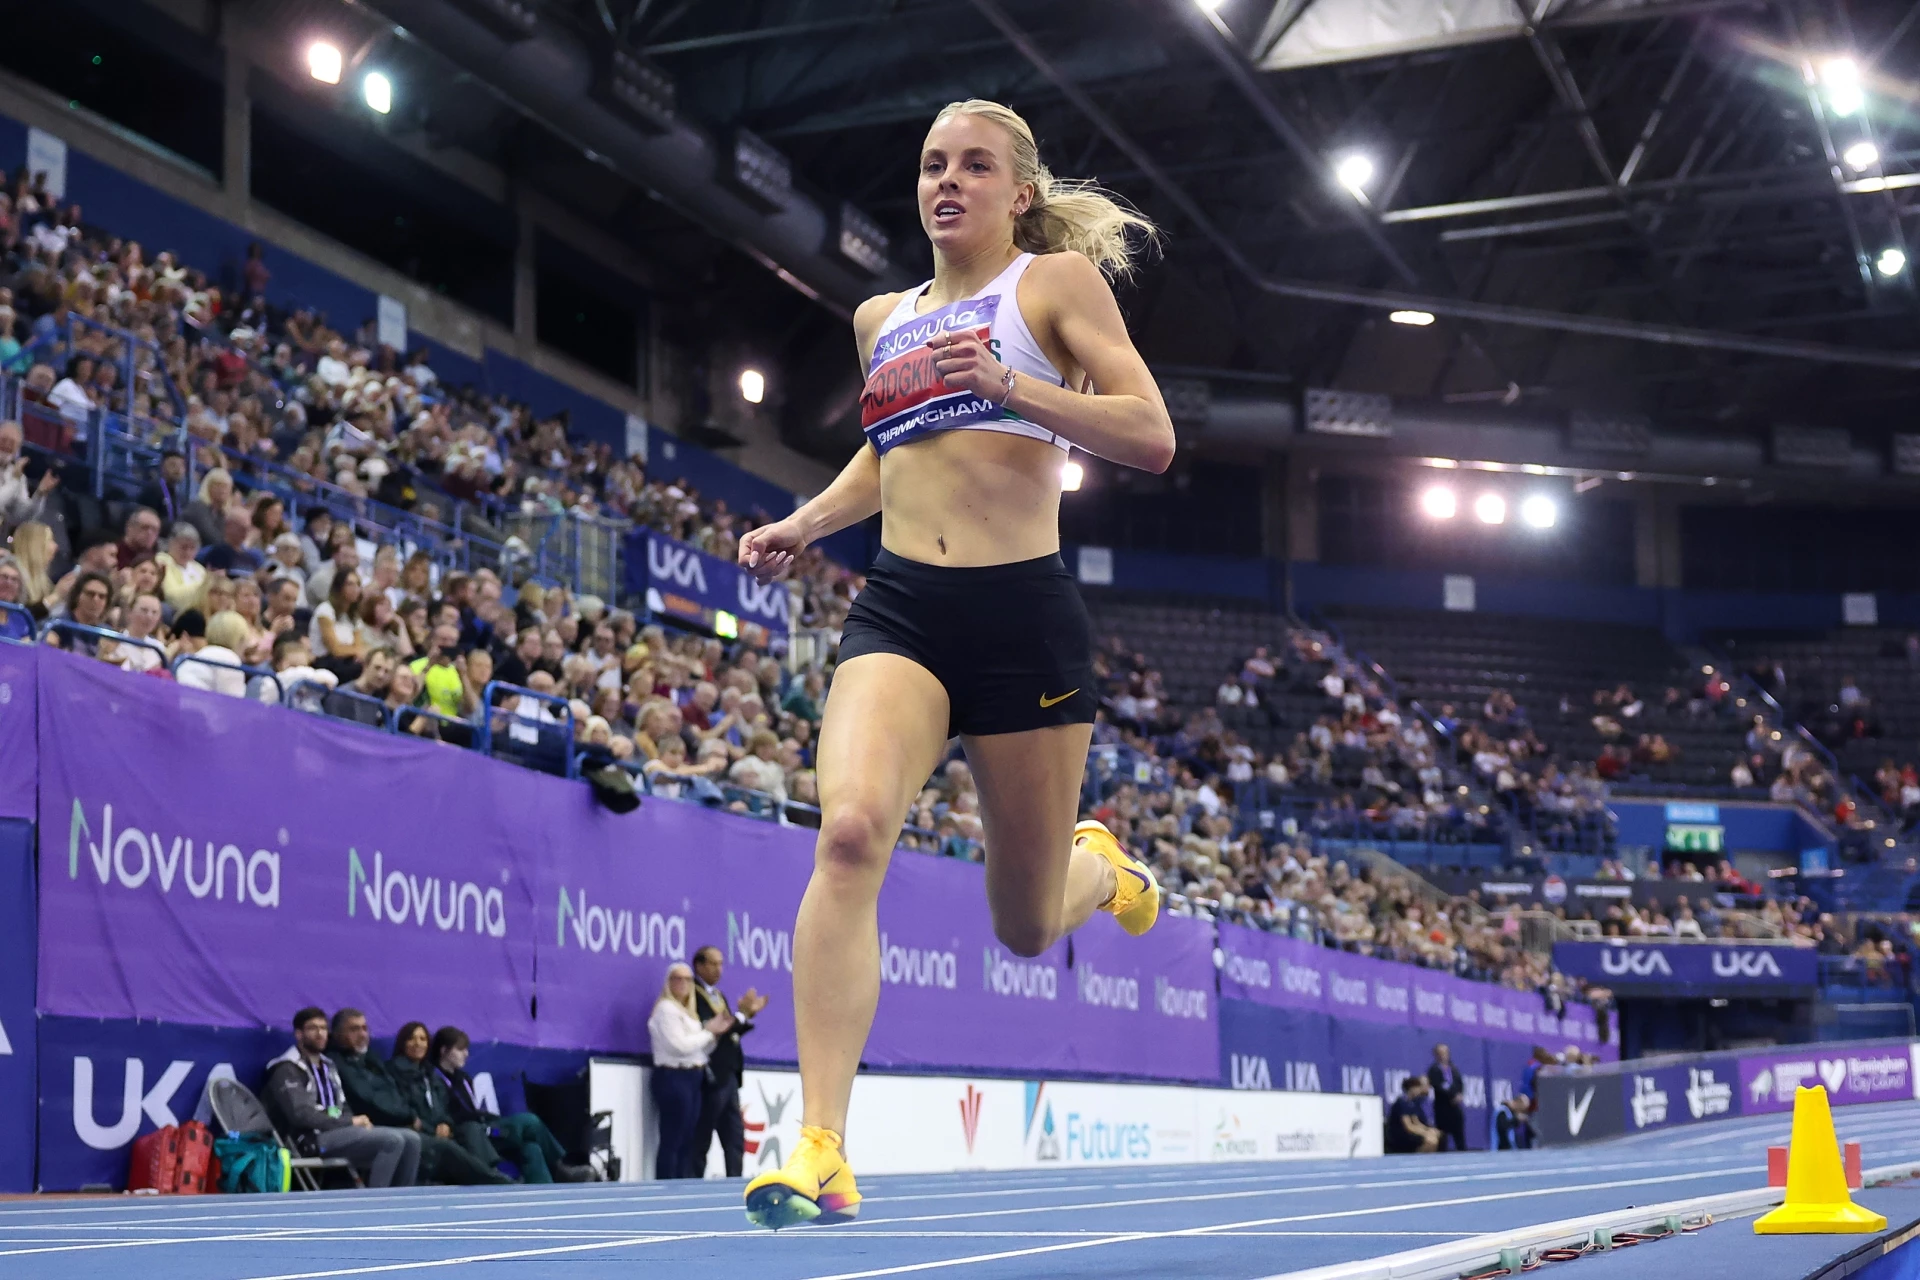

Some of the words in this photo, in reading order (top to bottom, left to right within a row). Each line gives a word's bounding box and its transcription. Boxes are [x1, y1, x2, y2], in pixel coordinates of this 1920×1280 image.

[879, 308, 977, 361] Novuna
[864, 355, 946, 414] HODGKIN
[877, 398, 994, 446] BIRMINGHAM
[647, 536, 708, 594] UKA
[69, 796, 280, 908] Novuna
[347, 847, 506, 938] Novuna
[557, 885, 686, 960] Novuna
[727, 910, 793, 974] Novu
[983, 946, 1058, 1001] Novuna
[1601, 949, 1673, 976] UKA
[1711, 951, 1783, 977] UKA
[1231, 1053, 1271, 1090] UKA
[1067, 1113, 1150, 1160] Futures
